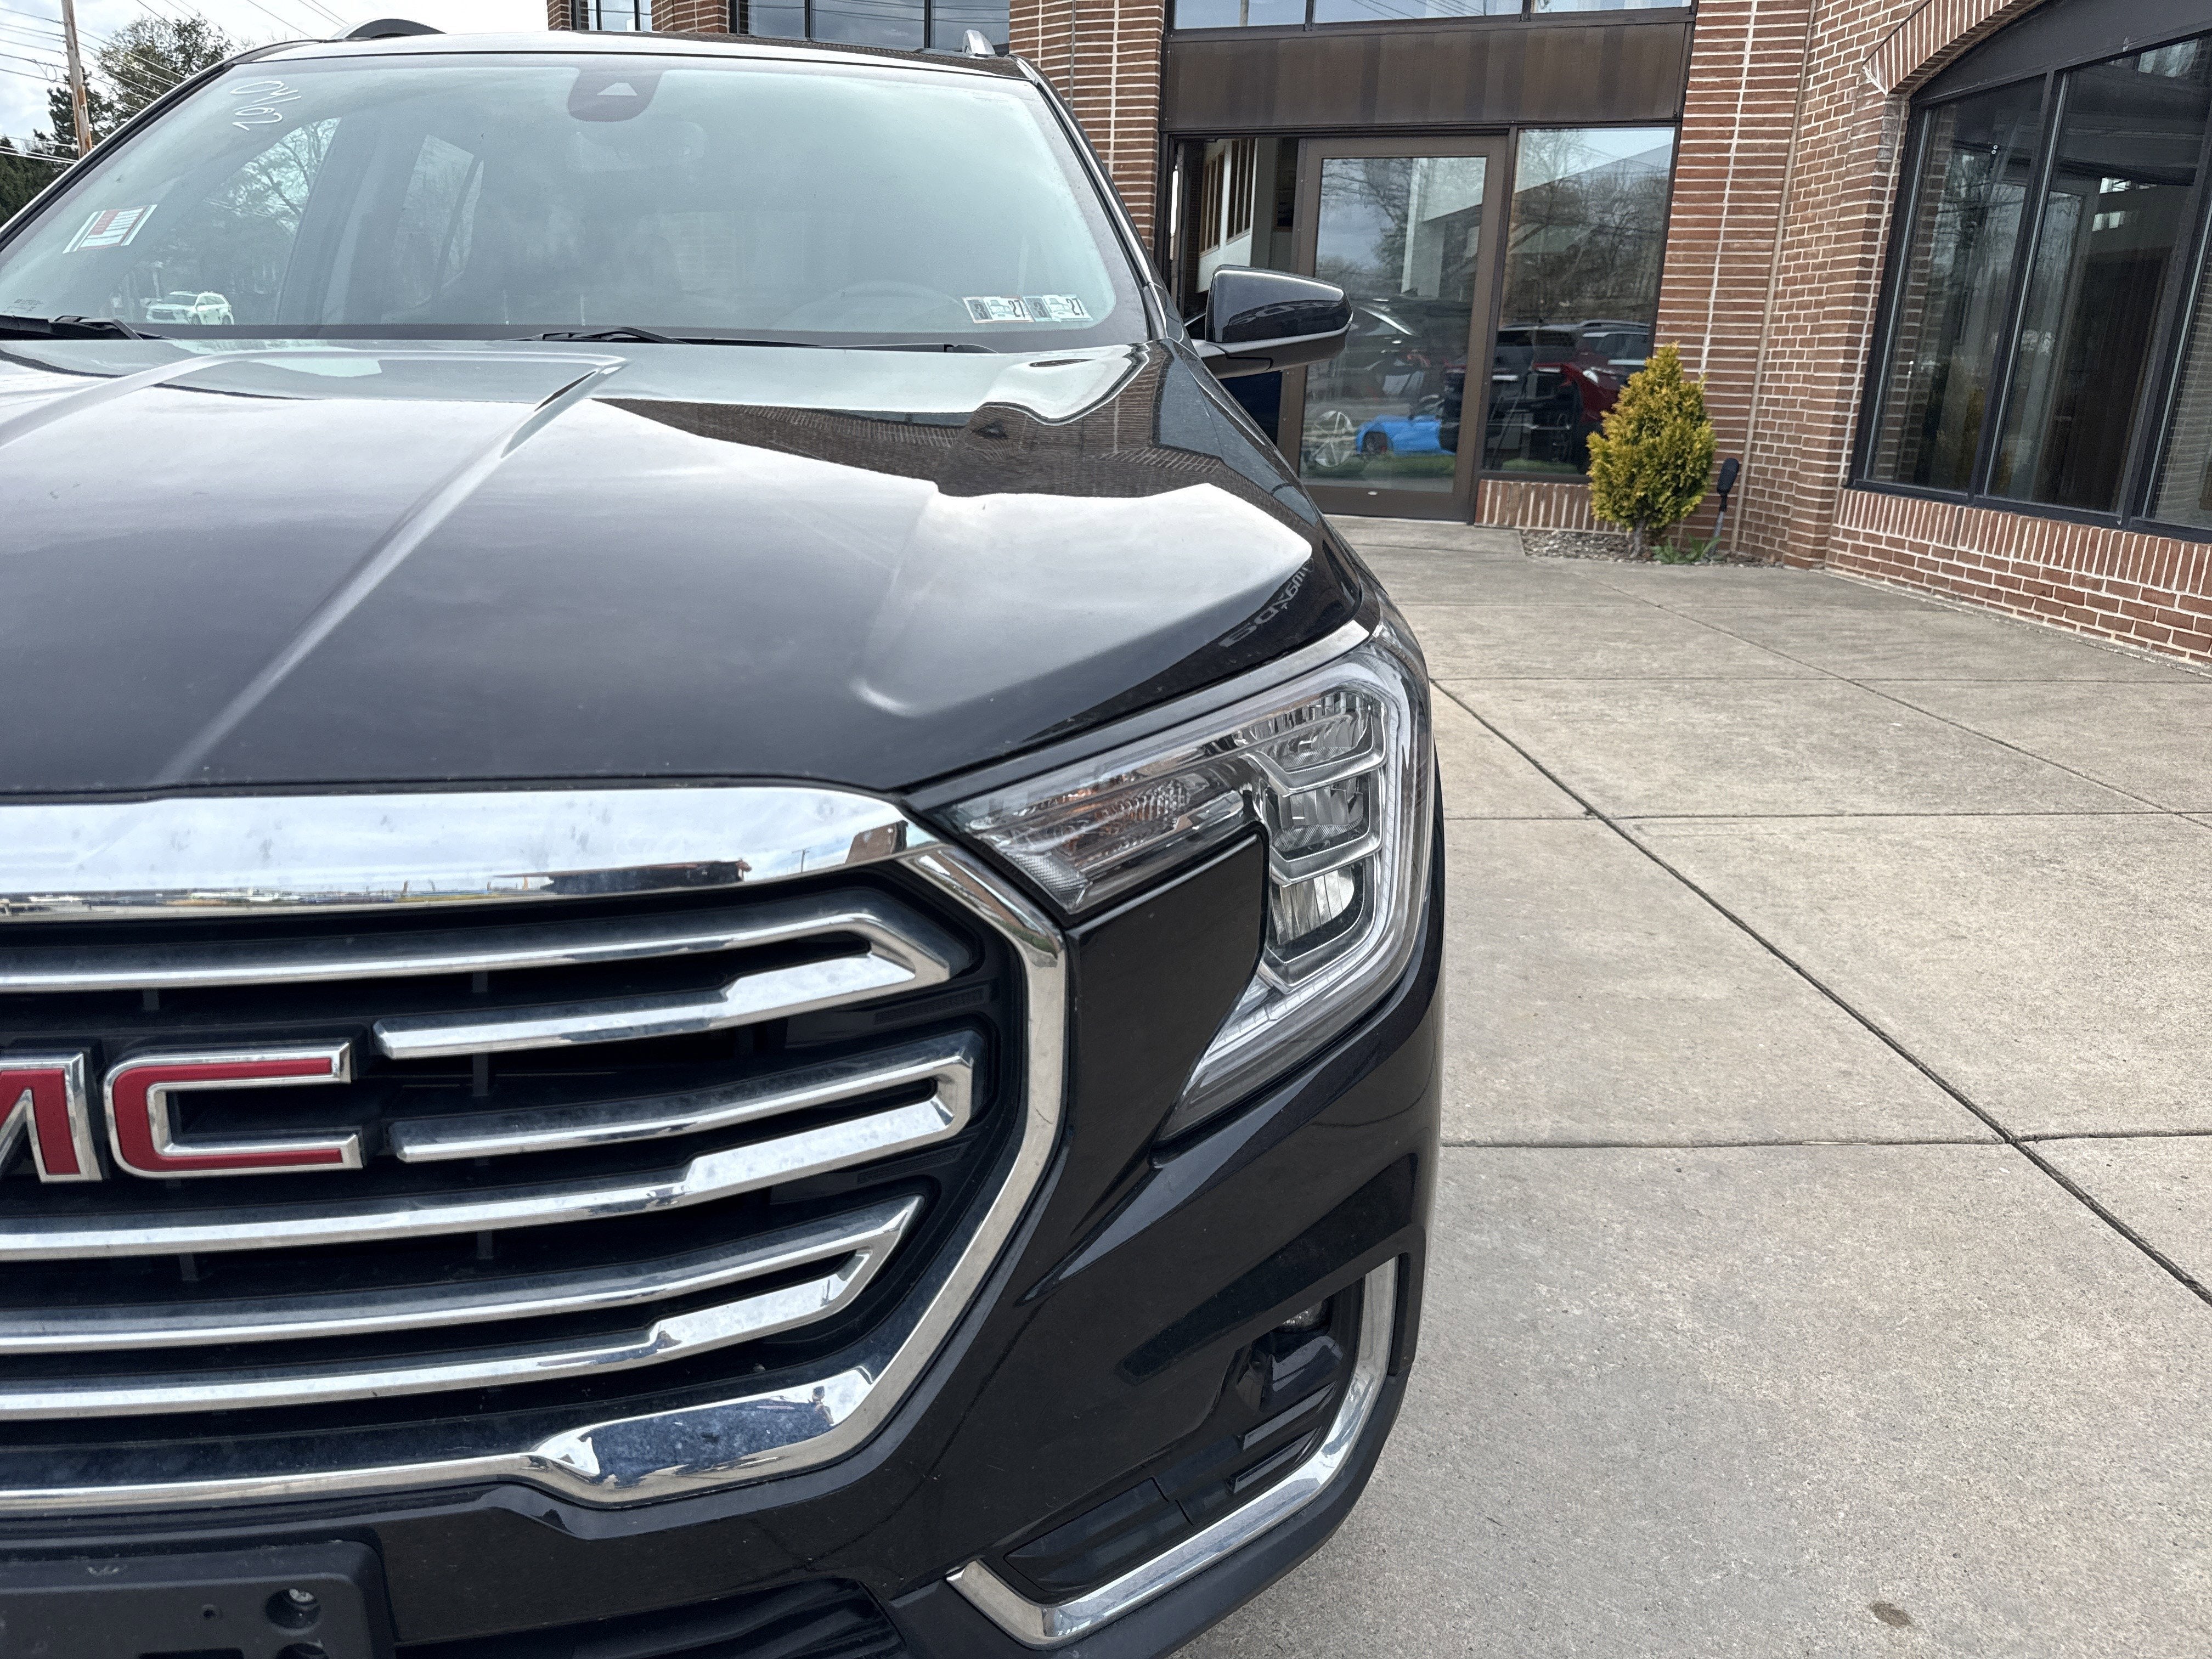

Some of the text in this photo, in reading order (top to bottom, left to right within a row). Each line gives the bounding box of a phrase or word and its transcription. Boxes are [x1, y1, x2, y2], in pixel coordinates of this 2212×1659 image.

[974, 300, 1025, 319] 3 27
[1034, 298, 1084, 318] 3 27
